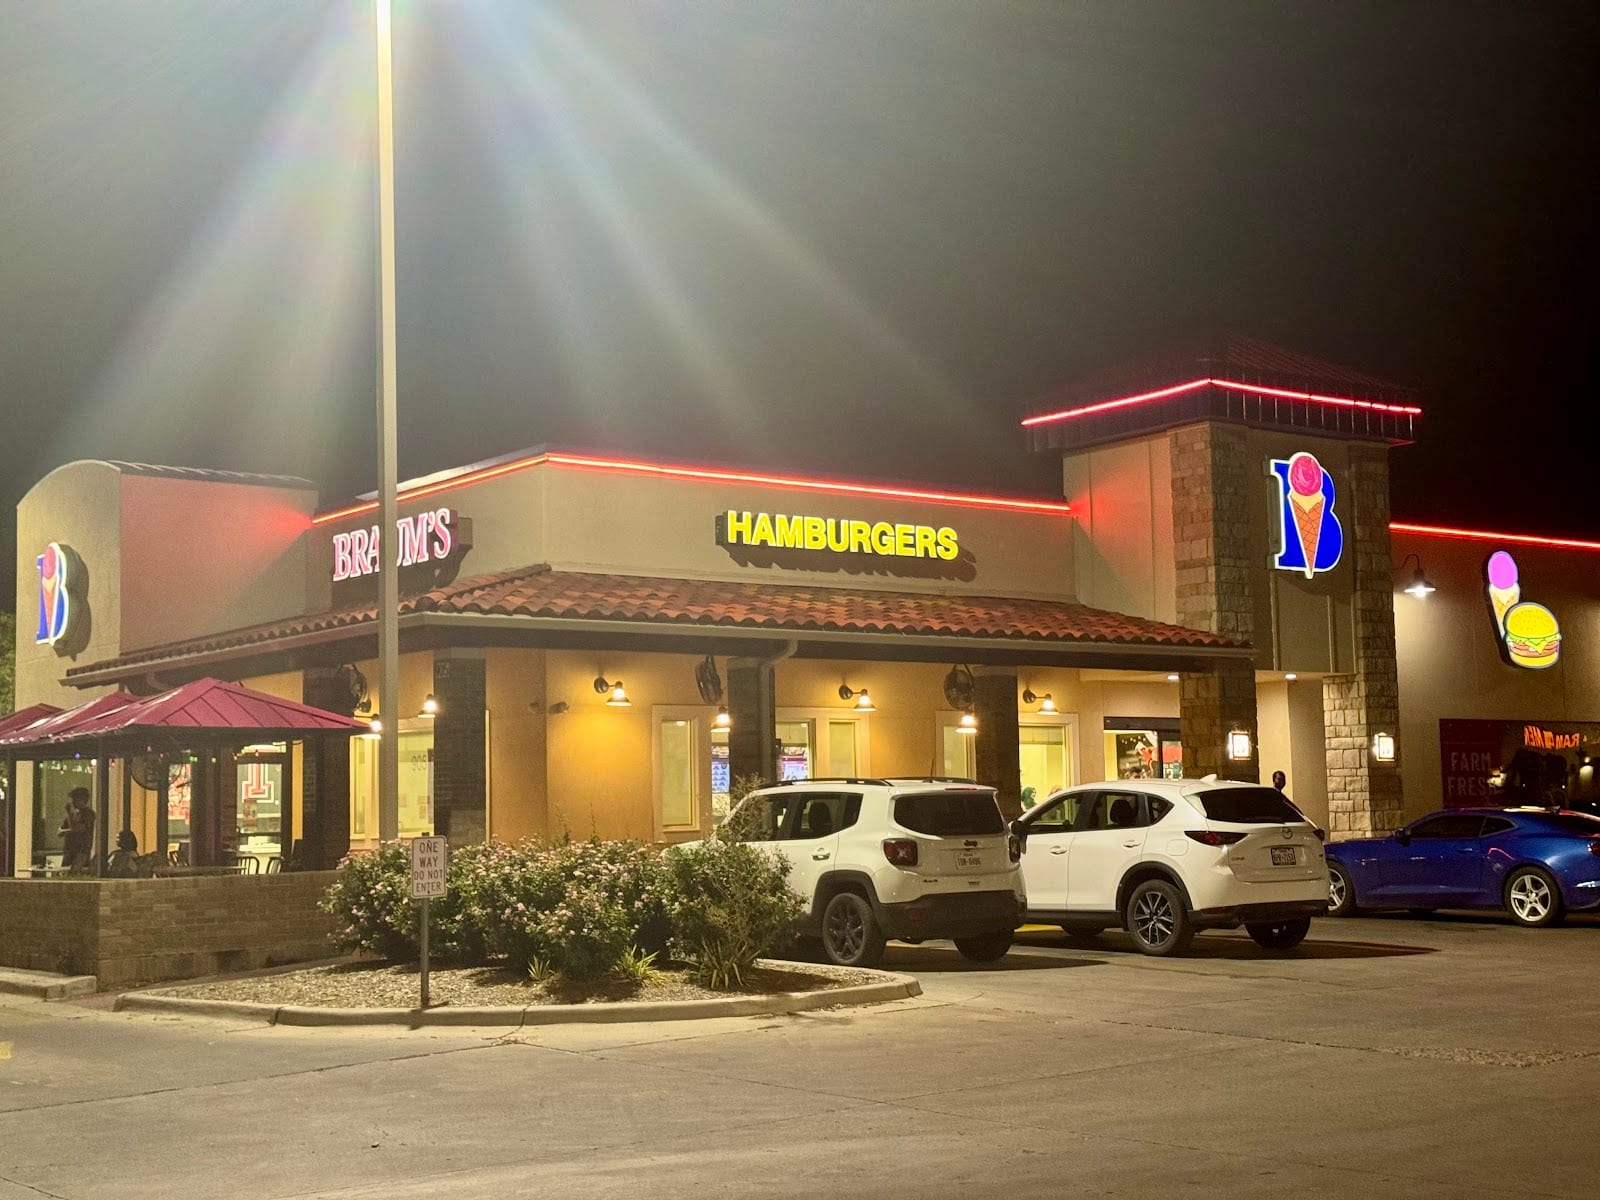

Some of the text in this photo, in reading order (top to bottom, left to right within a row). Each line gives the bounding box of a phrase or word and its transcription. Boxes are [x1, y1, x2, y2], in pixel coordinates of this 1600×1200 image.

[727, 510, 959, 560] HAMBURGERS
[333, 507, 452, 581] BRAM'S
[1451, 752, 1491, 771] FARM
[420, 841, 439, 853] ONE
[419, 856, 438, 868] WAY
[414, 869, 443, 880] DO NOT
[416, 881, 442, 893] ENTER
